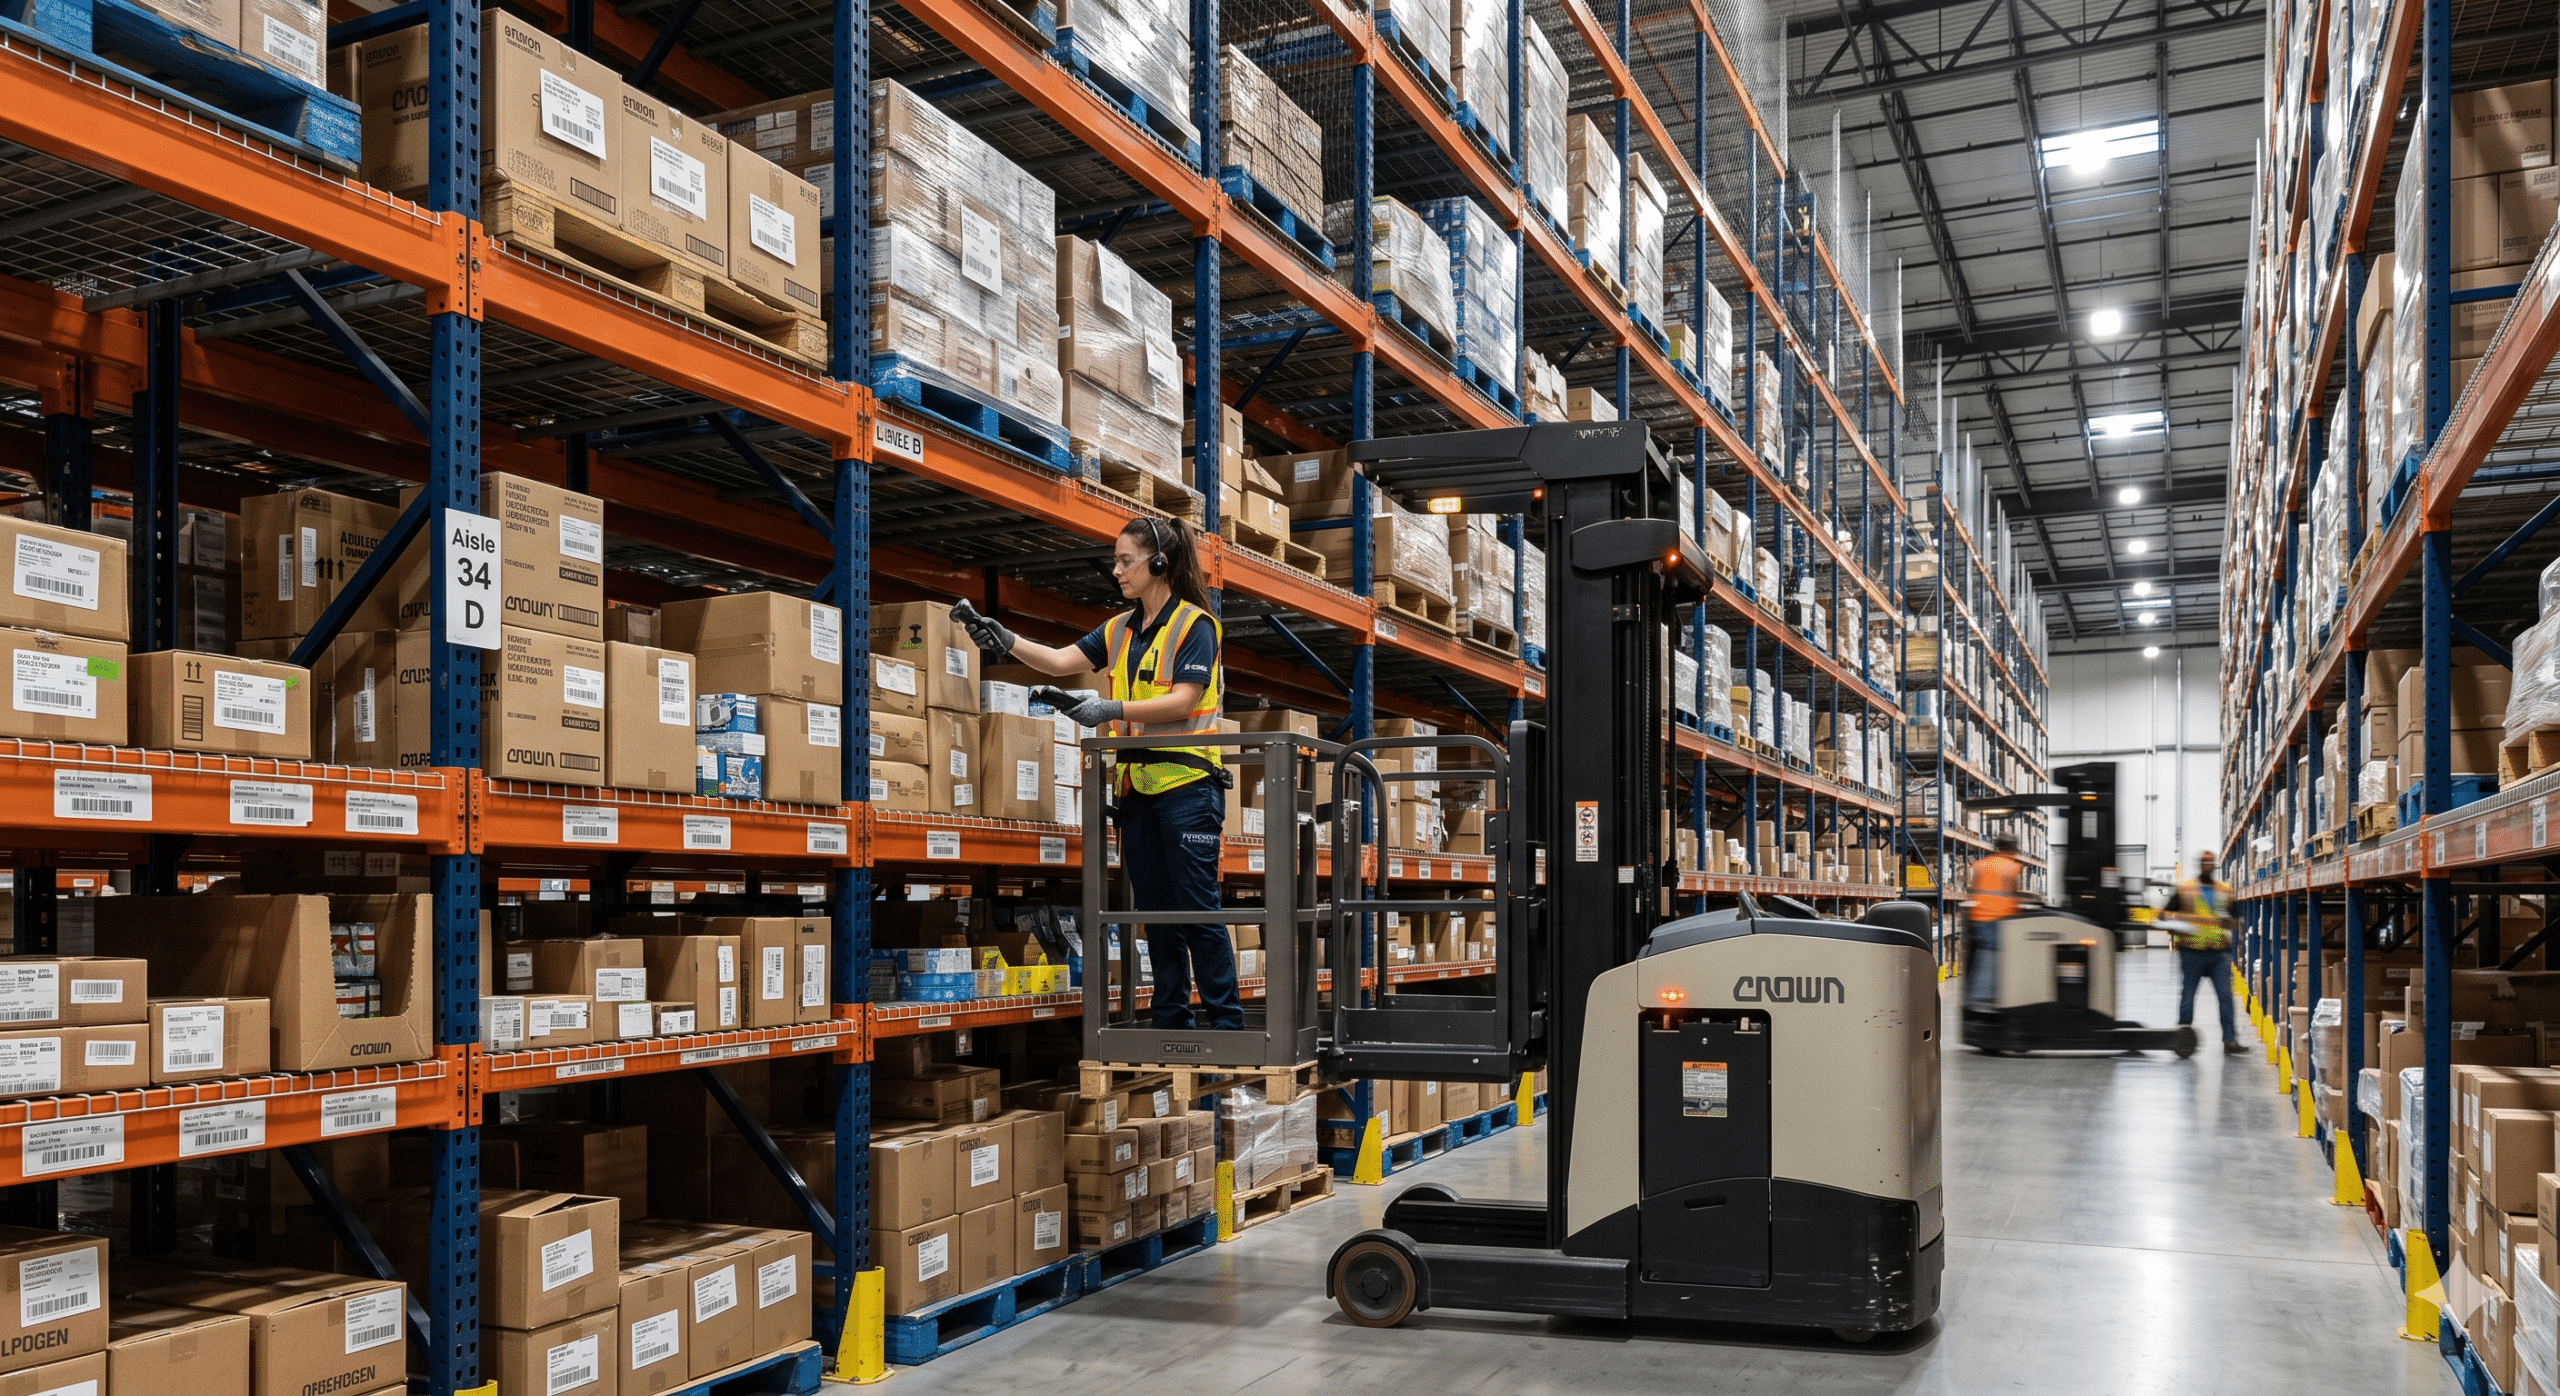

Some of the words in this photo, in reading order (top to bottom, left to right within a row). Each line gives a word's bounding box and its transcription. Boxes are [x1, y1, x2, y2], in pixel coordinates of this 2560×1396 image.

[452, 528, 495, 554] Aisle
[457, 557, 492, 590] 34
[465, 600, 485, 629] D
[1733, 976, 1845, 1004] CROWN
[1, 1328, 68, 1357] LPOGEN
